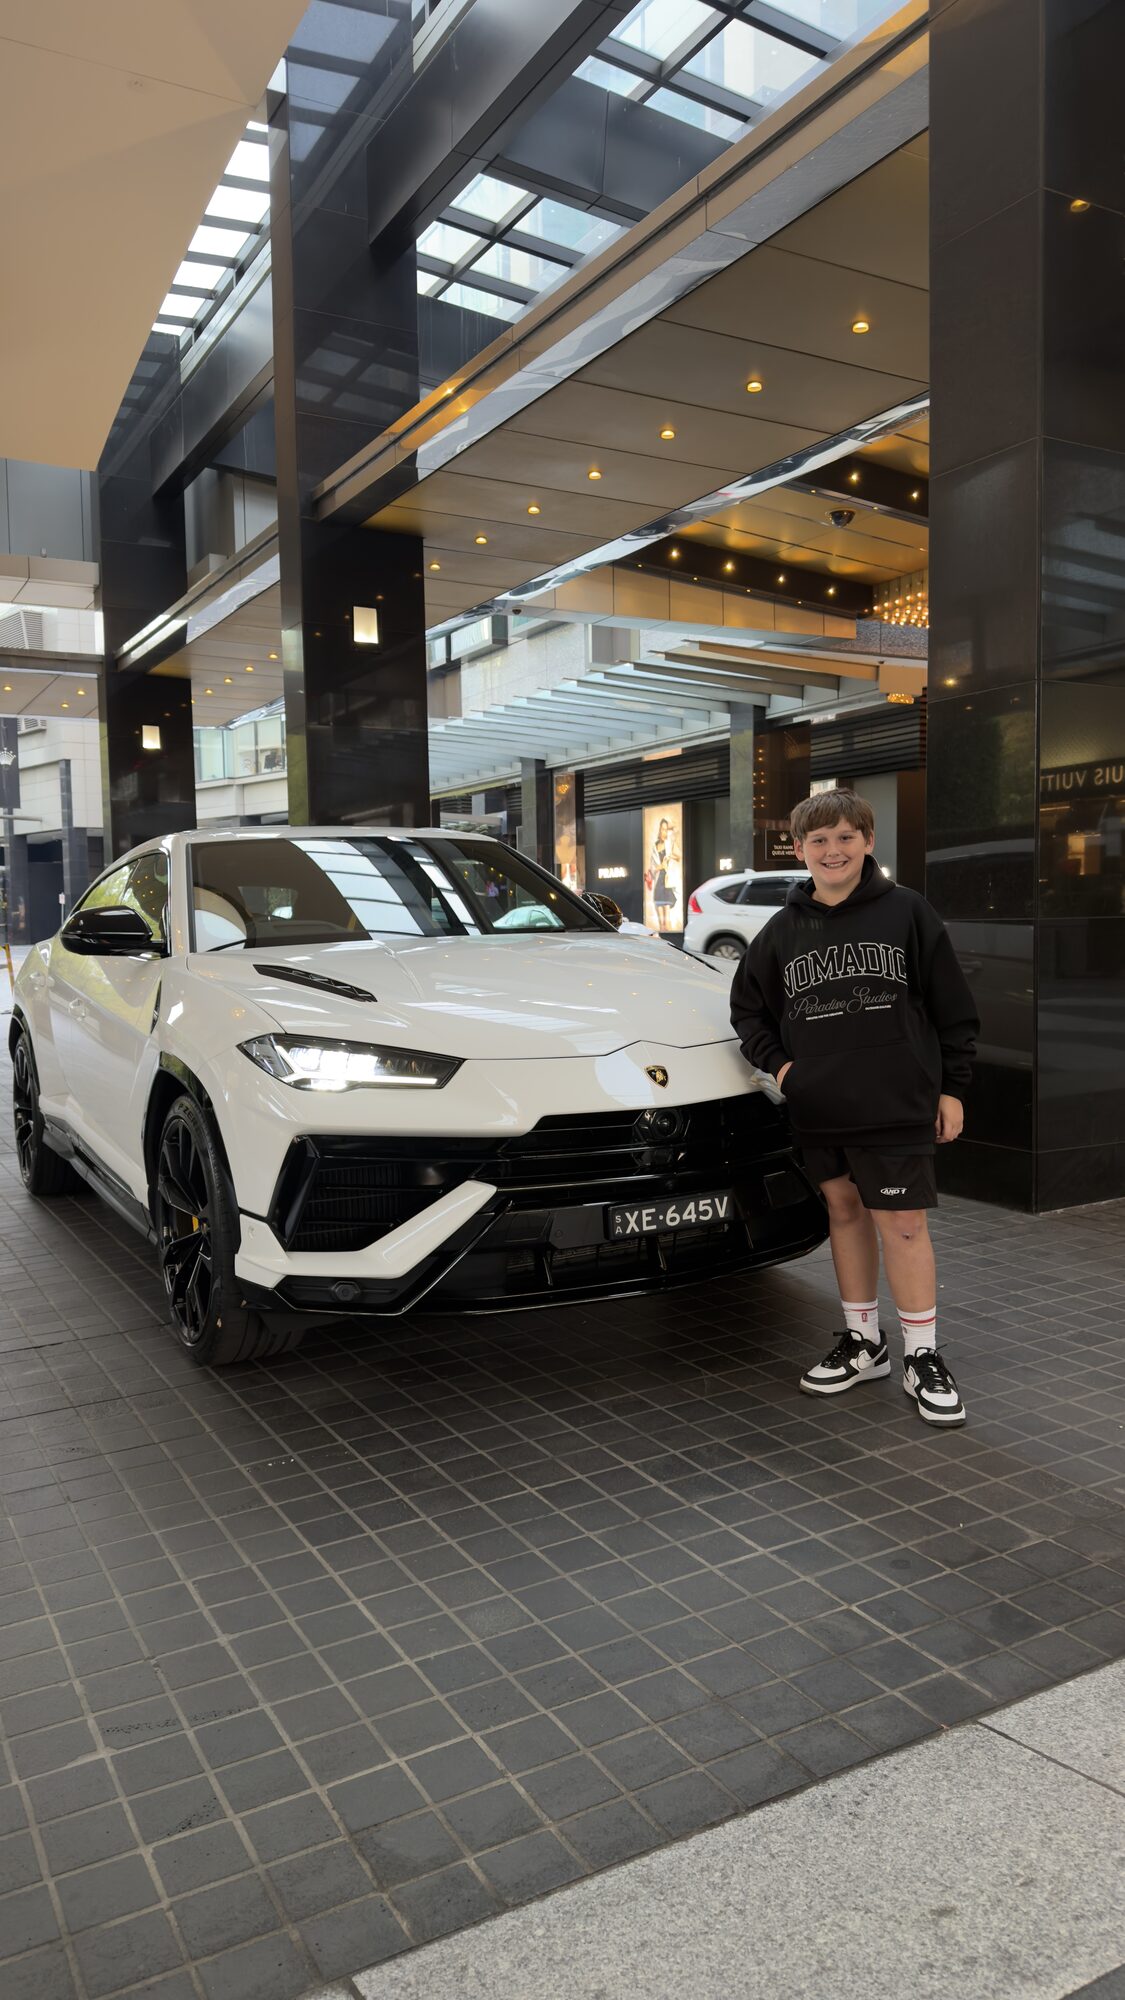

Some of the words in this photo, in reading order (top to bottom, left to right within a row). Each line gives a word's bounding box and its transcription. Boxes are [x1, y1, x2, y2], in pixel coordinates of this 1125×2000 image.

[598, 867, 625, 879] PRADA
[788, 995, 848, 1020] Paradise
[847, 985, 898, 1013] Studios
